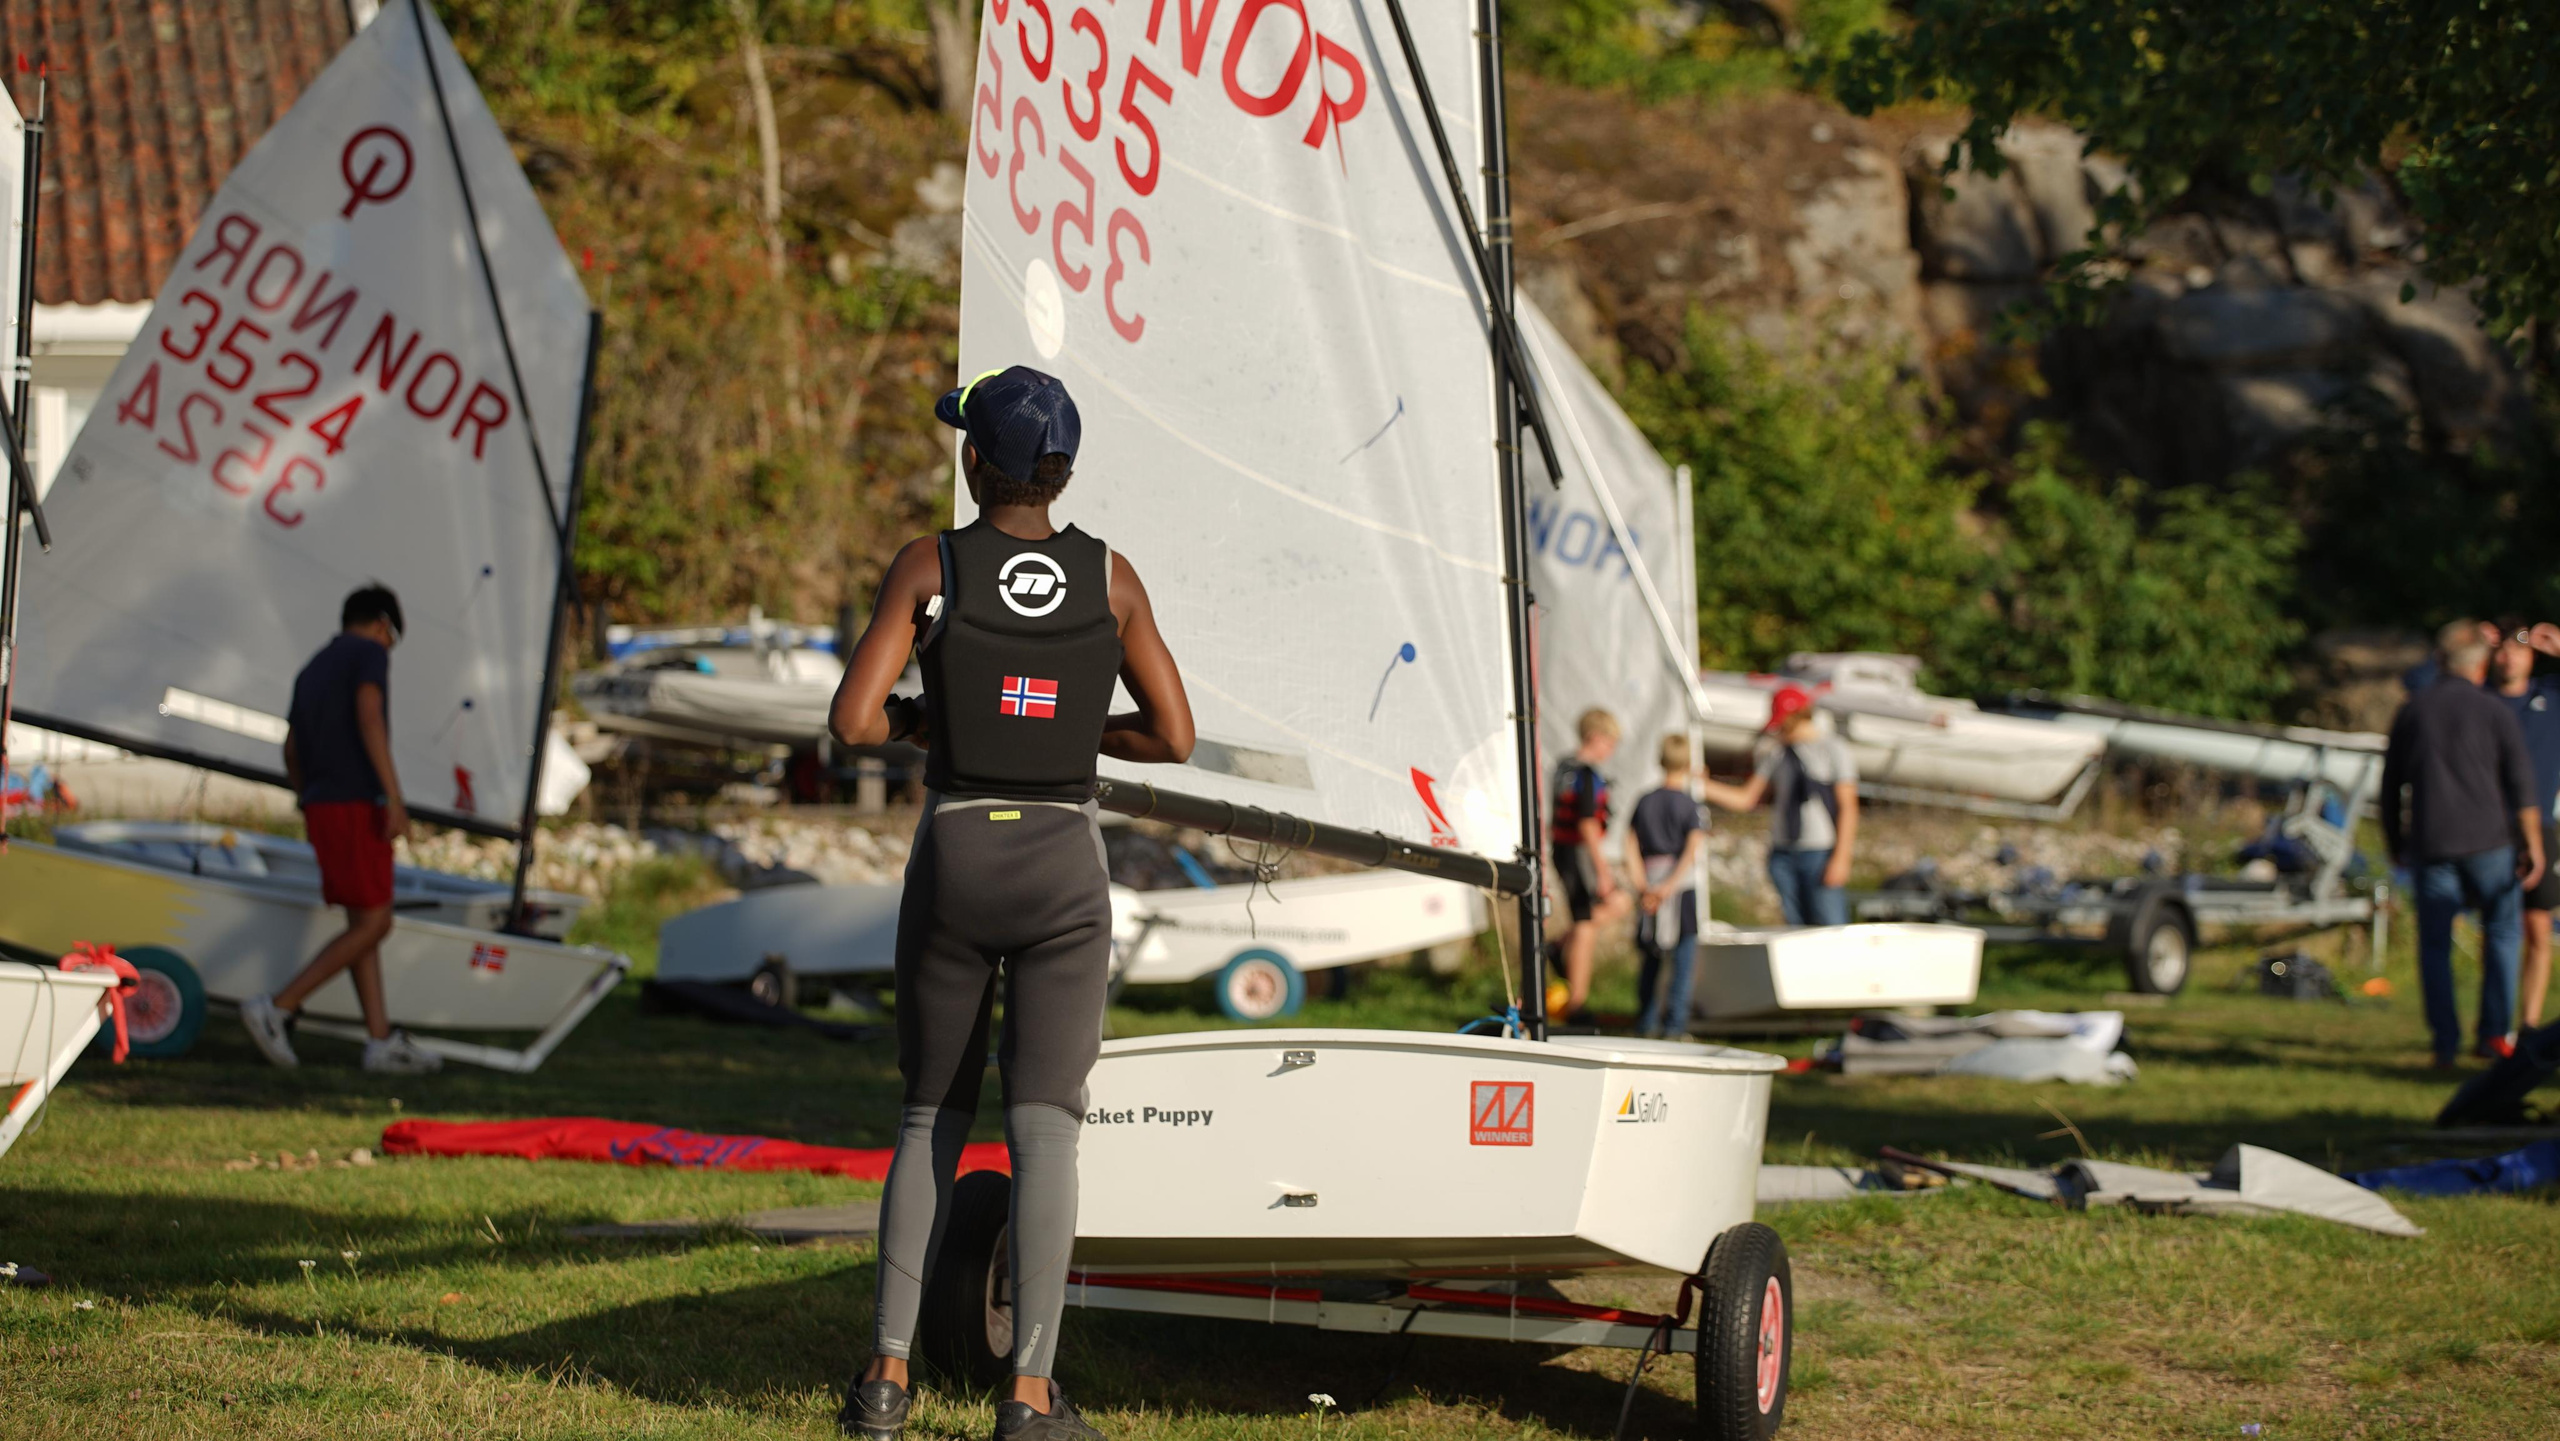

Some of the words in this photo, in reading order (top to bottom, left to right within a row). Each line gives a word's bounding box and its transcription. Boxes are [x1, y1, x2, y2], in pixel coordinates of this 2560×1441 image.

[160, 288, 364, 456] 3524
[354, 311, 510, 460] NOR
[1143, 1106, 1213, 1127] Puppy
[1638, 1092, 1668, 1123] SailOn
[1474, 1131, 1529, 1143] WINNER
